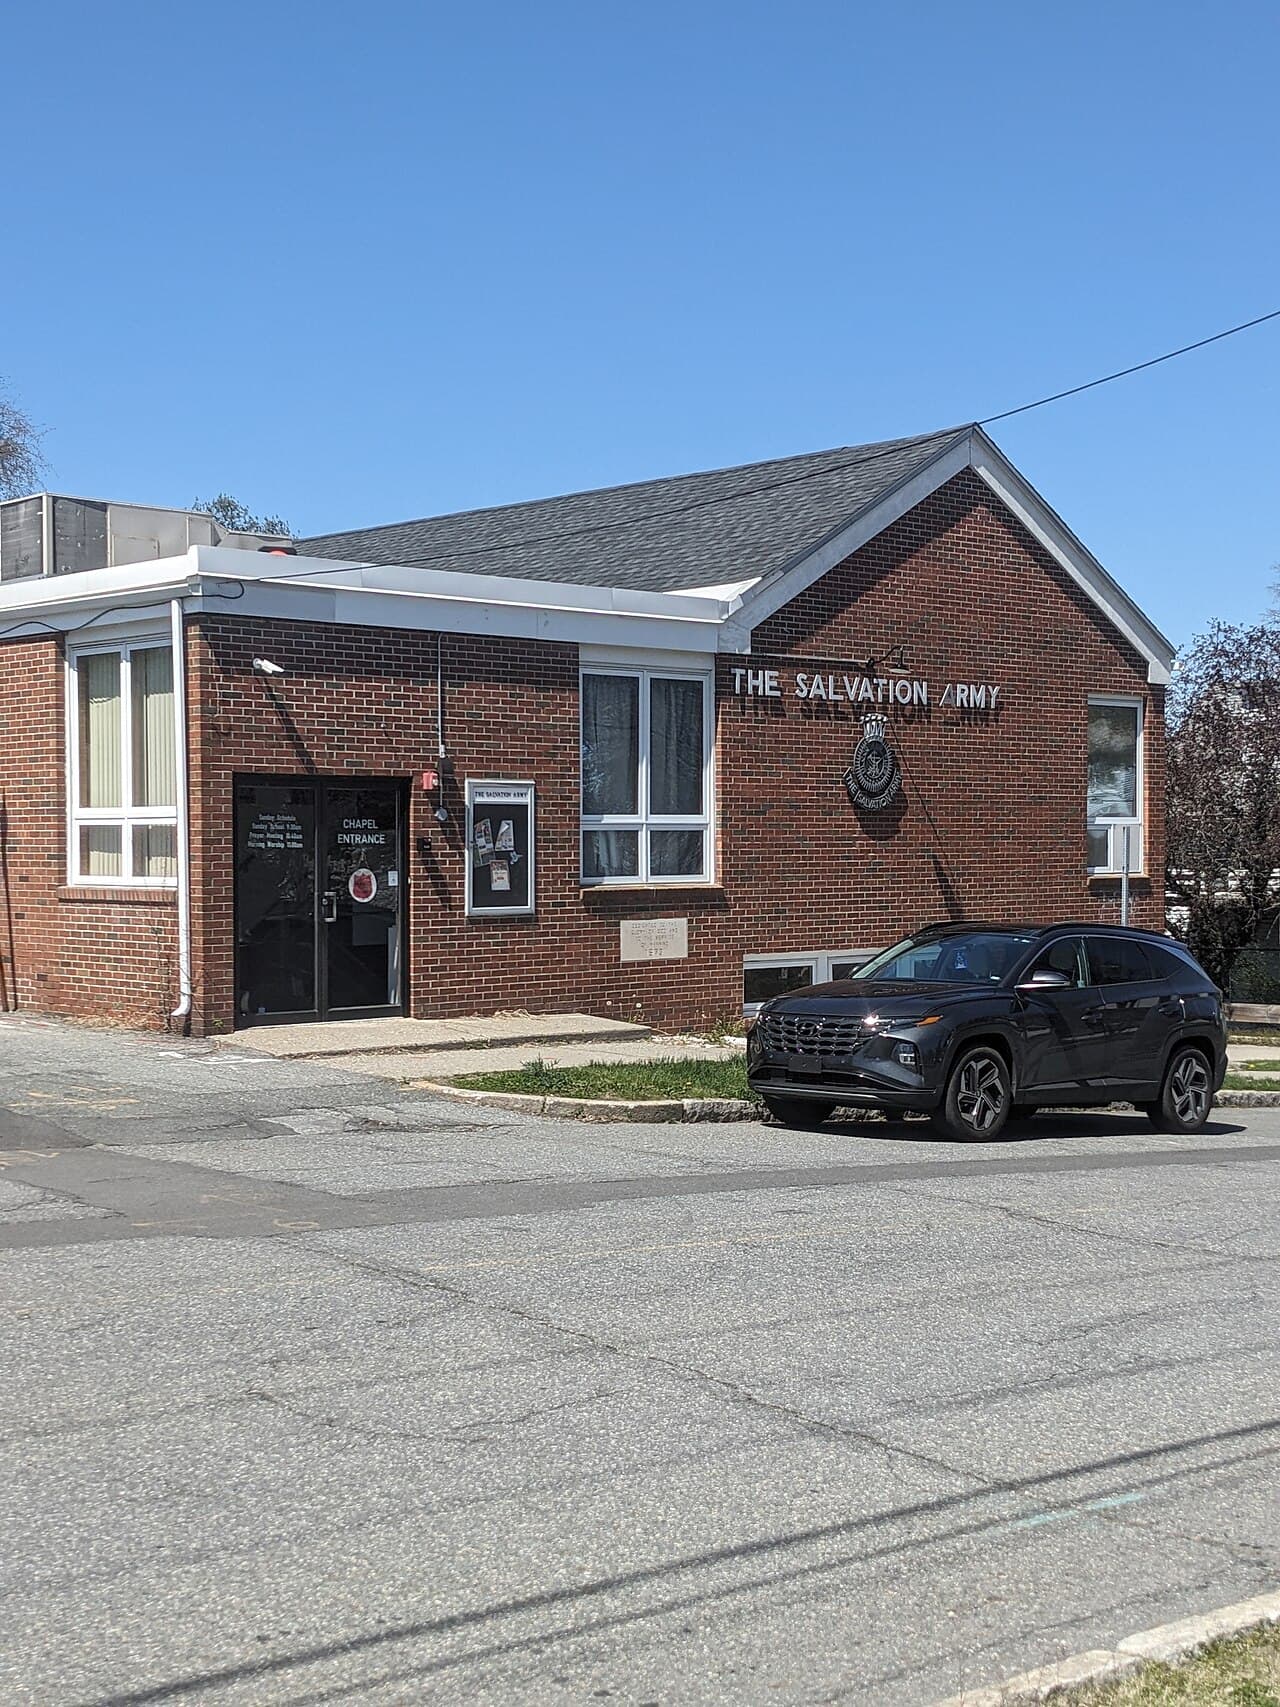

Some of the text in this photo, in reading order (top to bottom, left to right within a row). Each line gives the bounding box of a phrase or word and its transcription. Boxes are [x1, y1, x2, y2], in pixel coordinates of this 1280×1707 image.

[731, 668, 1000, 709] THE SALVATION ARMY
[846, 773, 859, 795] THE
[343, 819, 379, 829] CHAPEL
[337, 833, 386, 845] ENTRANCE
